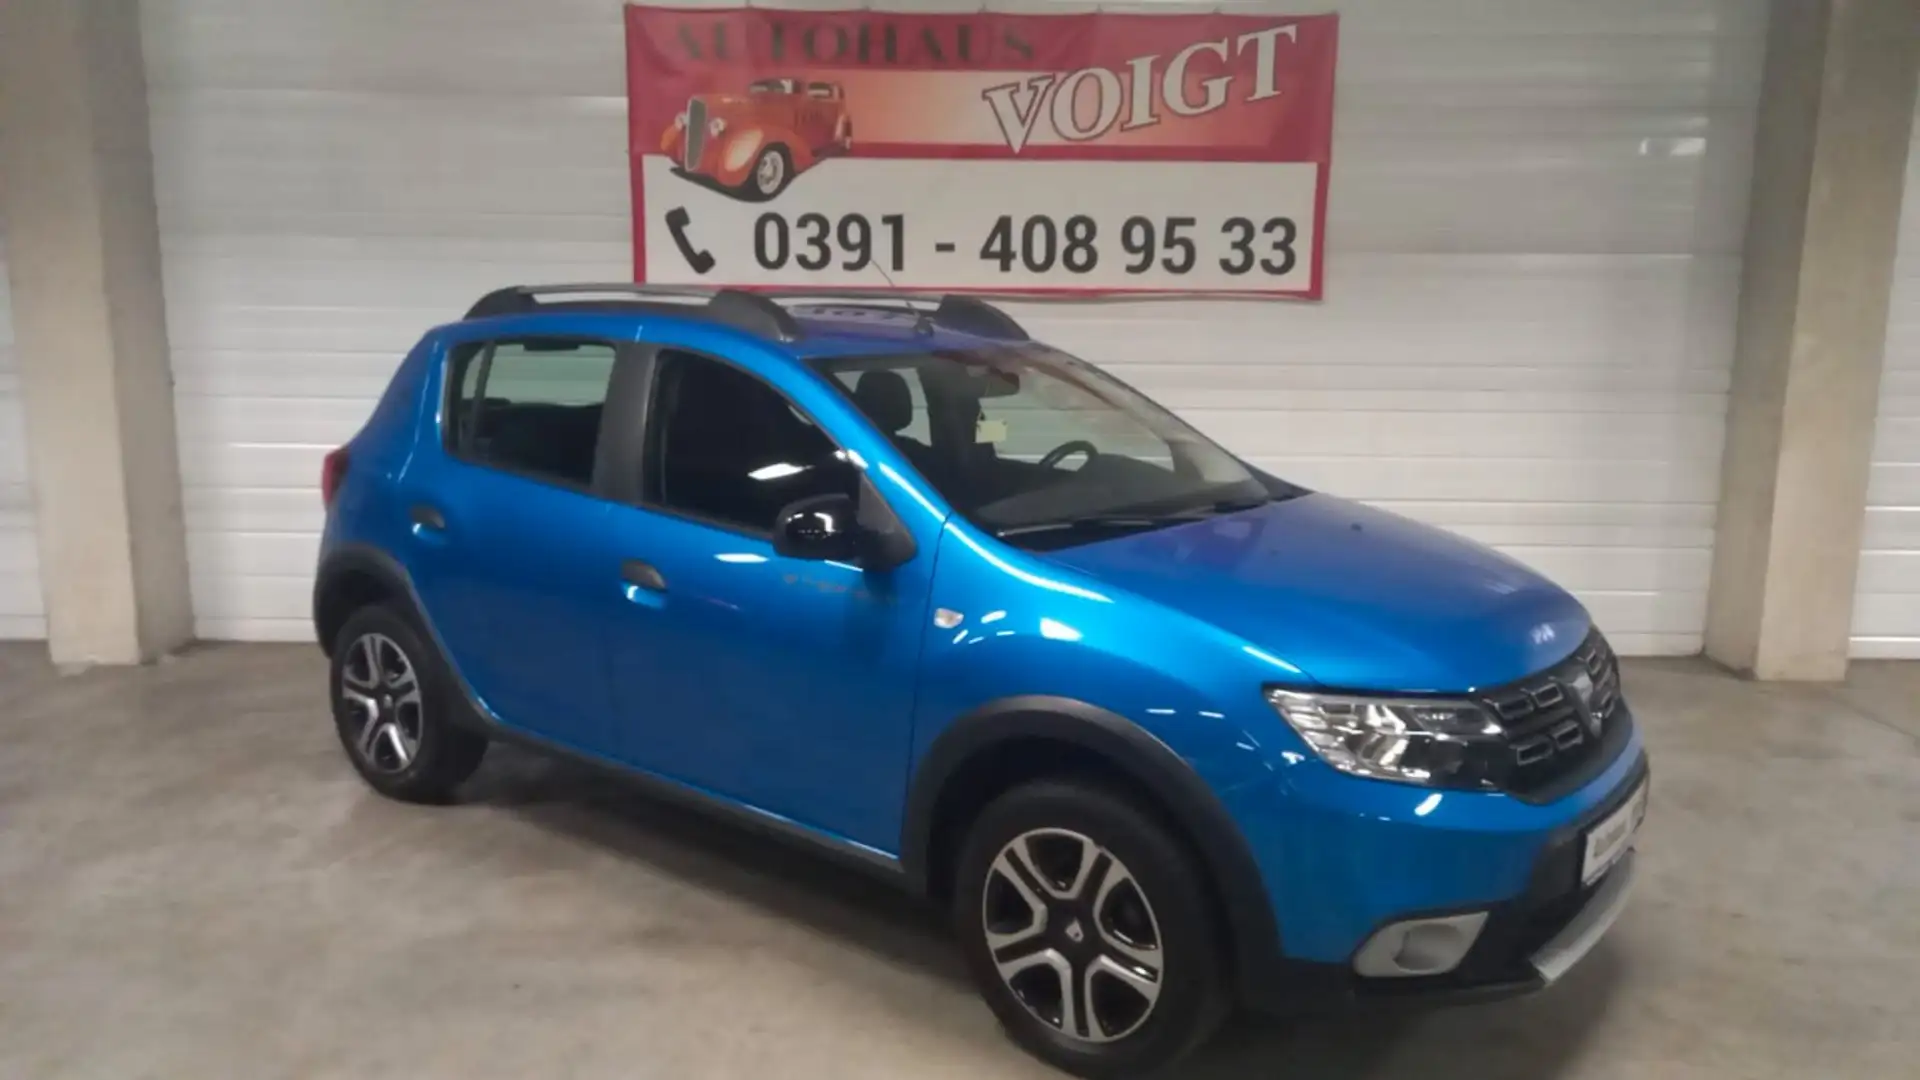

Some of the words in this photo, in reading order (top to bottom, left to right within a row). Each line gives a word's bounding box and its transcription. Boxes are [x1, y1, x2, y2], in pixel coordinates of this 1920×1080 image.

[671, 21, 1035, 64] AUTOHAUS
[982, 24, 1297, 154] VOIGT
[754, 212, 904, 271] 0391
[935, 242, 955, 252] -
[979, 214, 1098, 273] 408
[1121, 216, 1196, 274] 95
[1219, 217, 1297, 275] 33
